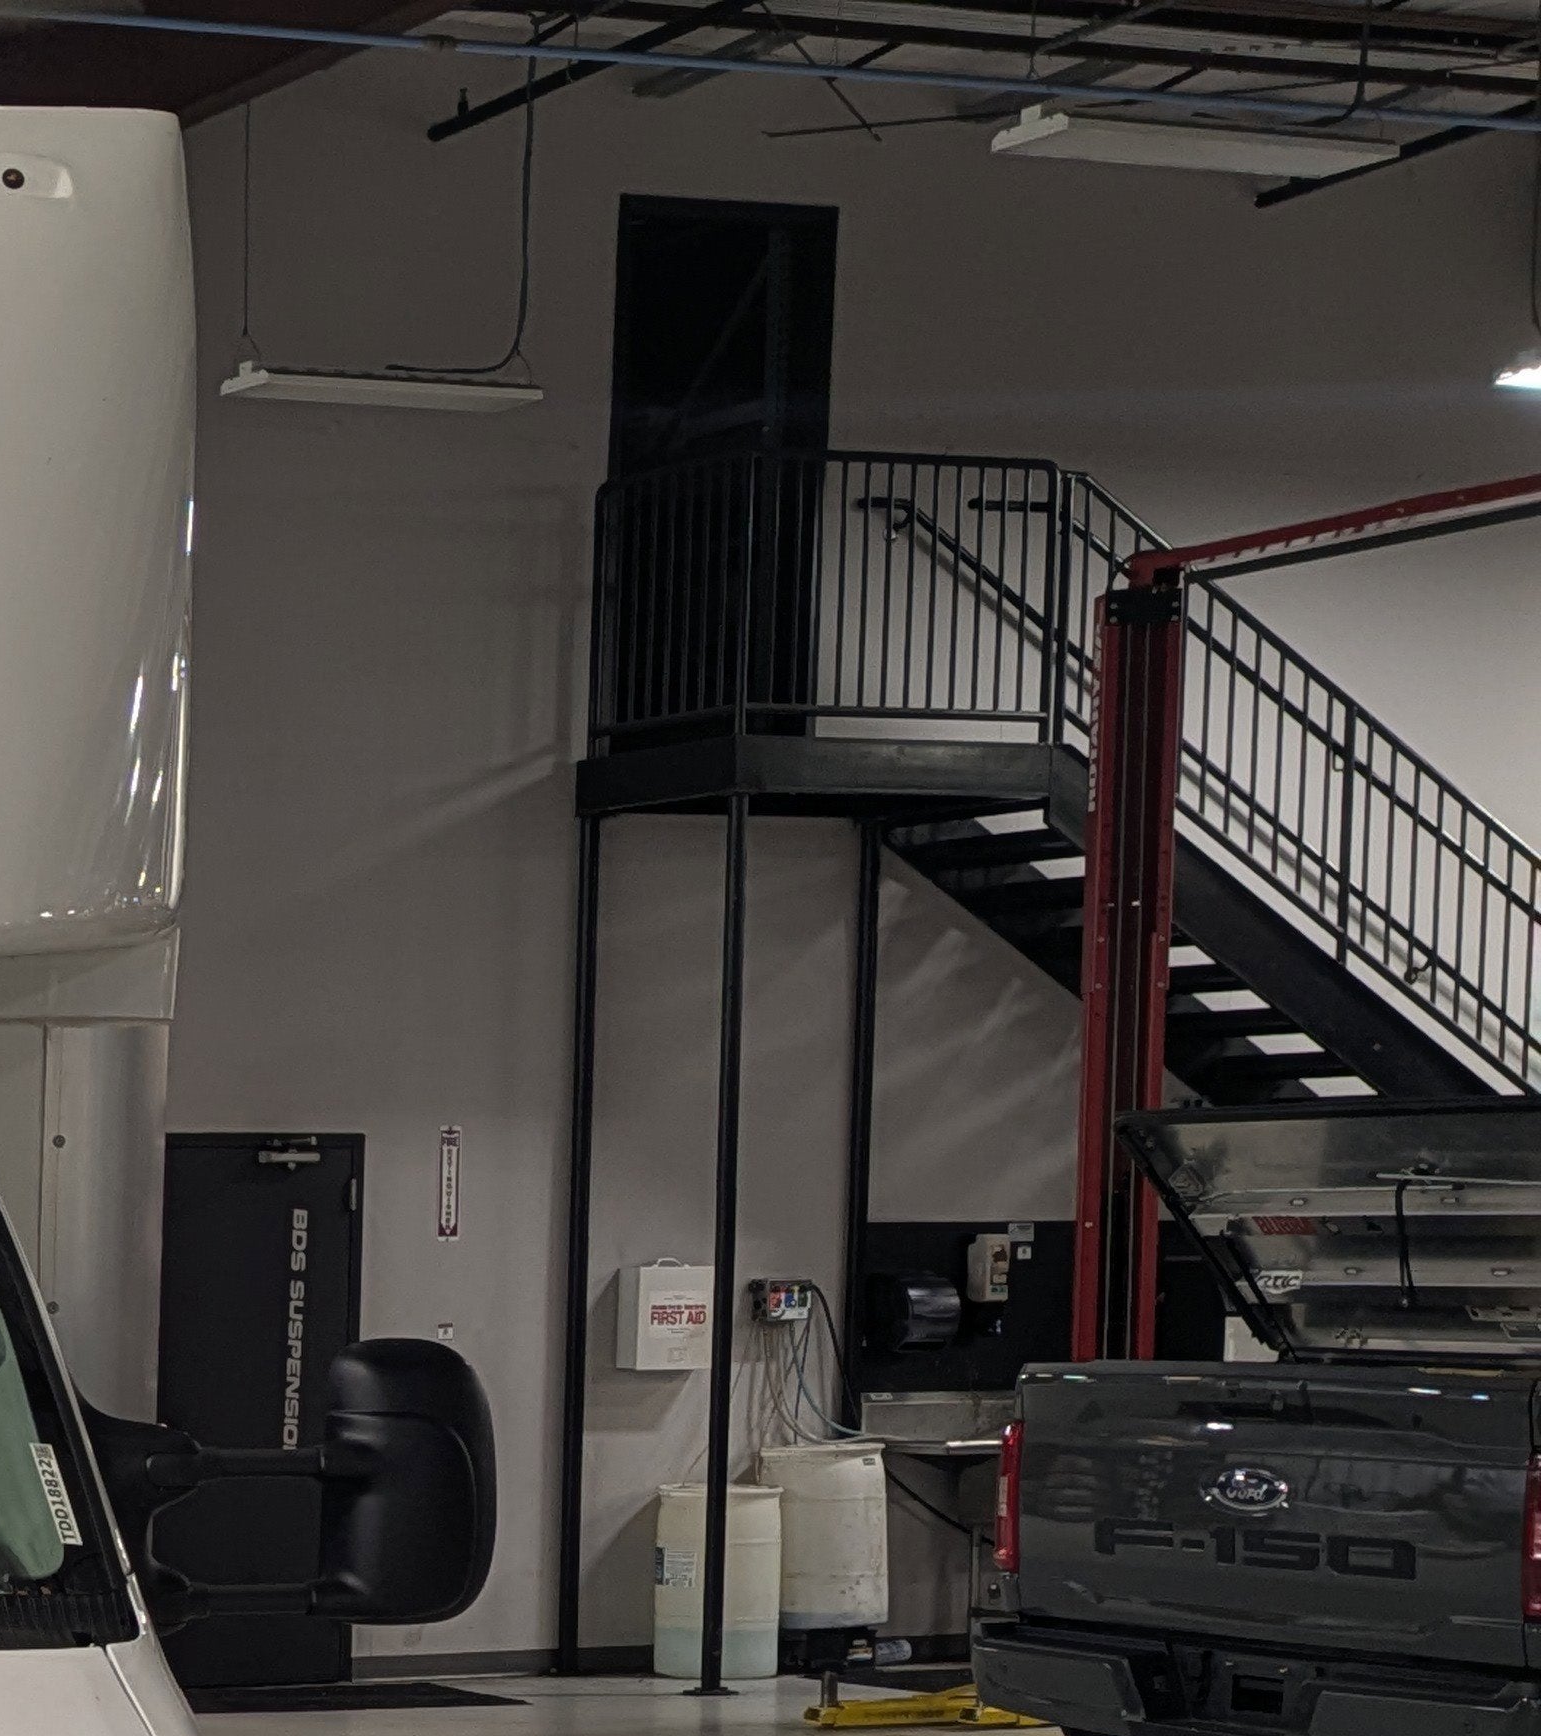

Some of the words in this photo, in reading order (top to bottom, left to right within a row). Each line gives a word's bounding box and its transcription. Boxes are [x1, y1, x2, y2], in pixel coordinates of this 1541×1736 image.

[291, 1208, 309, 1272] BDS
[650, 1310, 685, 1325] FIRST
[686, 1310, 707, 1325] AID
[1094, 1516, 1417, 1581] F-150
